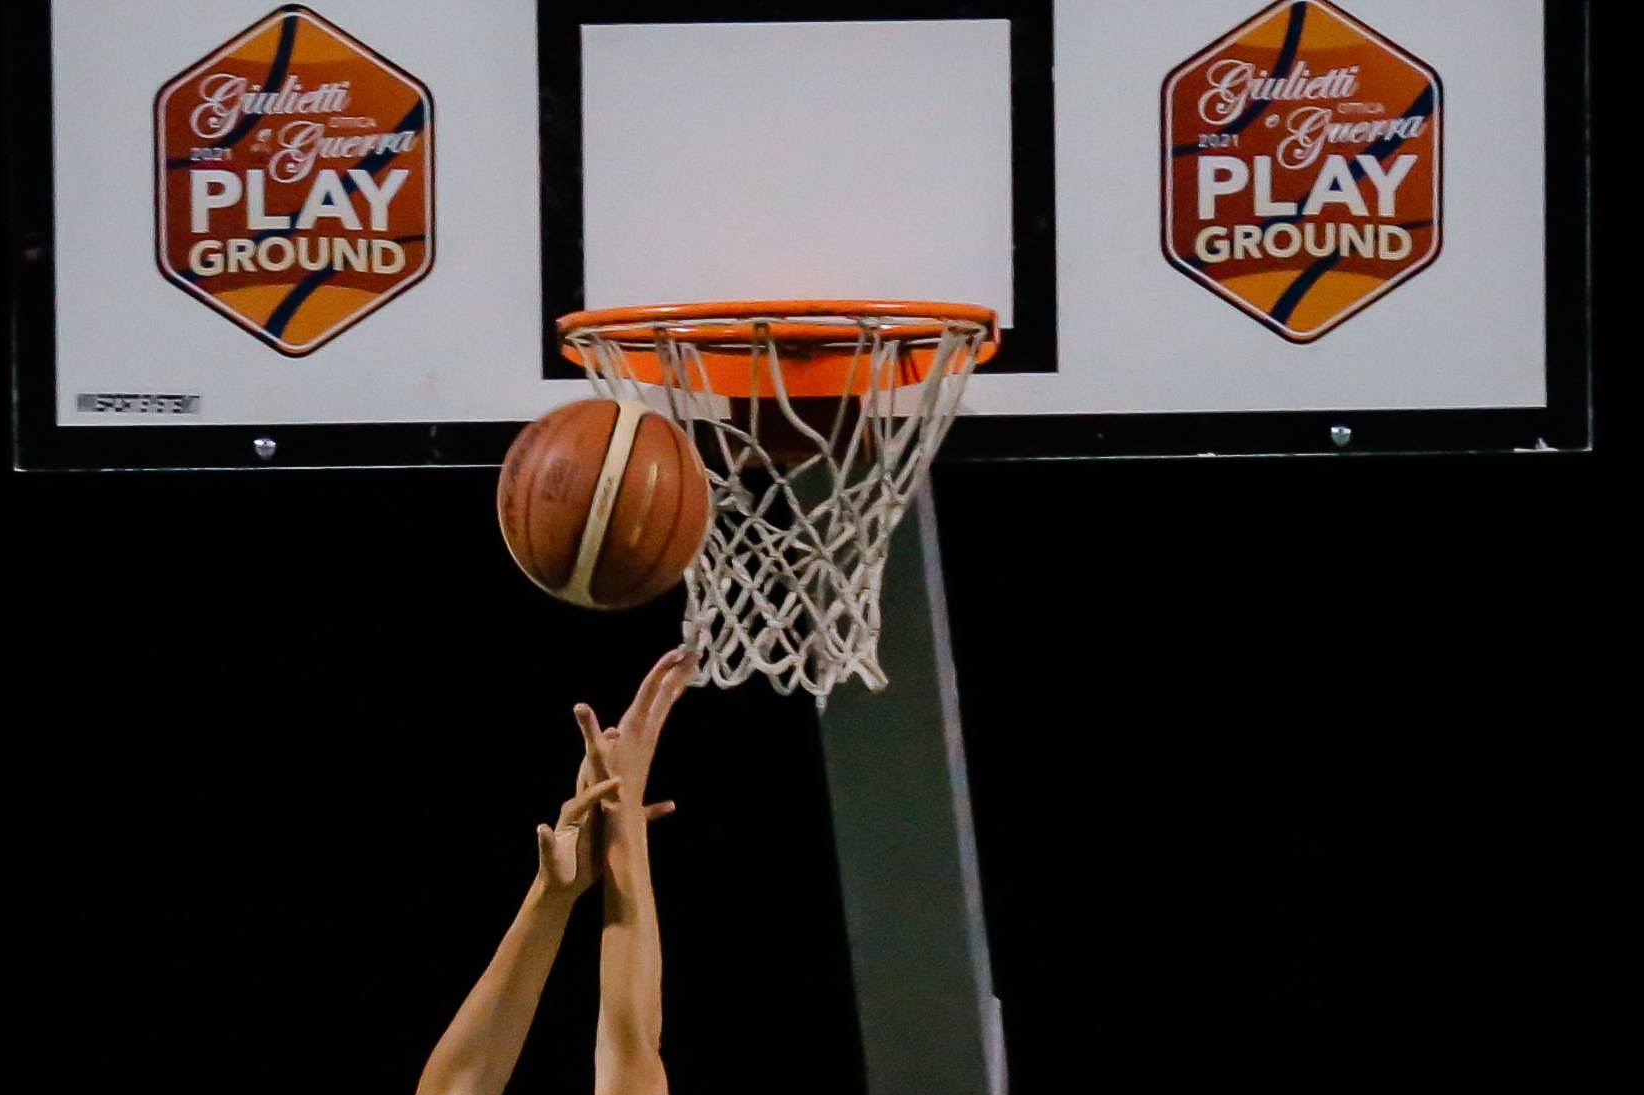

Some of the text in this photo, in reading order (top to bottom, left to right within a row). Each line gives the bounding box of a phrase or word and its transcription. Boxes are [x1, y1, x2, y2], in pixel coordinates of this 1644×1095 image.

[189, 73, 352, 139] Giulietti
[1198, 58, 1359, 126] Giulietti
[268, 121, 416, 183] Guerra
[1276, 106, 1426, 170] Guerra
[190, 169, 410, 234] PLAY
[1197, 154, 1419, 220] PLAY
[189, 236, 407, 277] GROUND
[1195, 222, 1413, 264] GROUND
